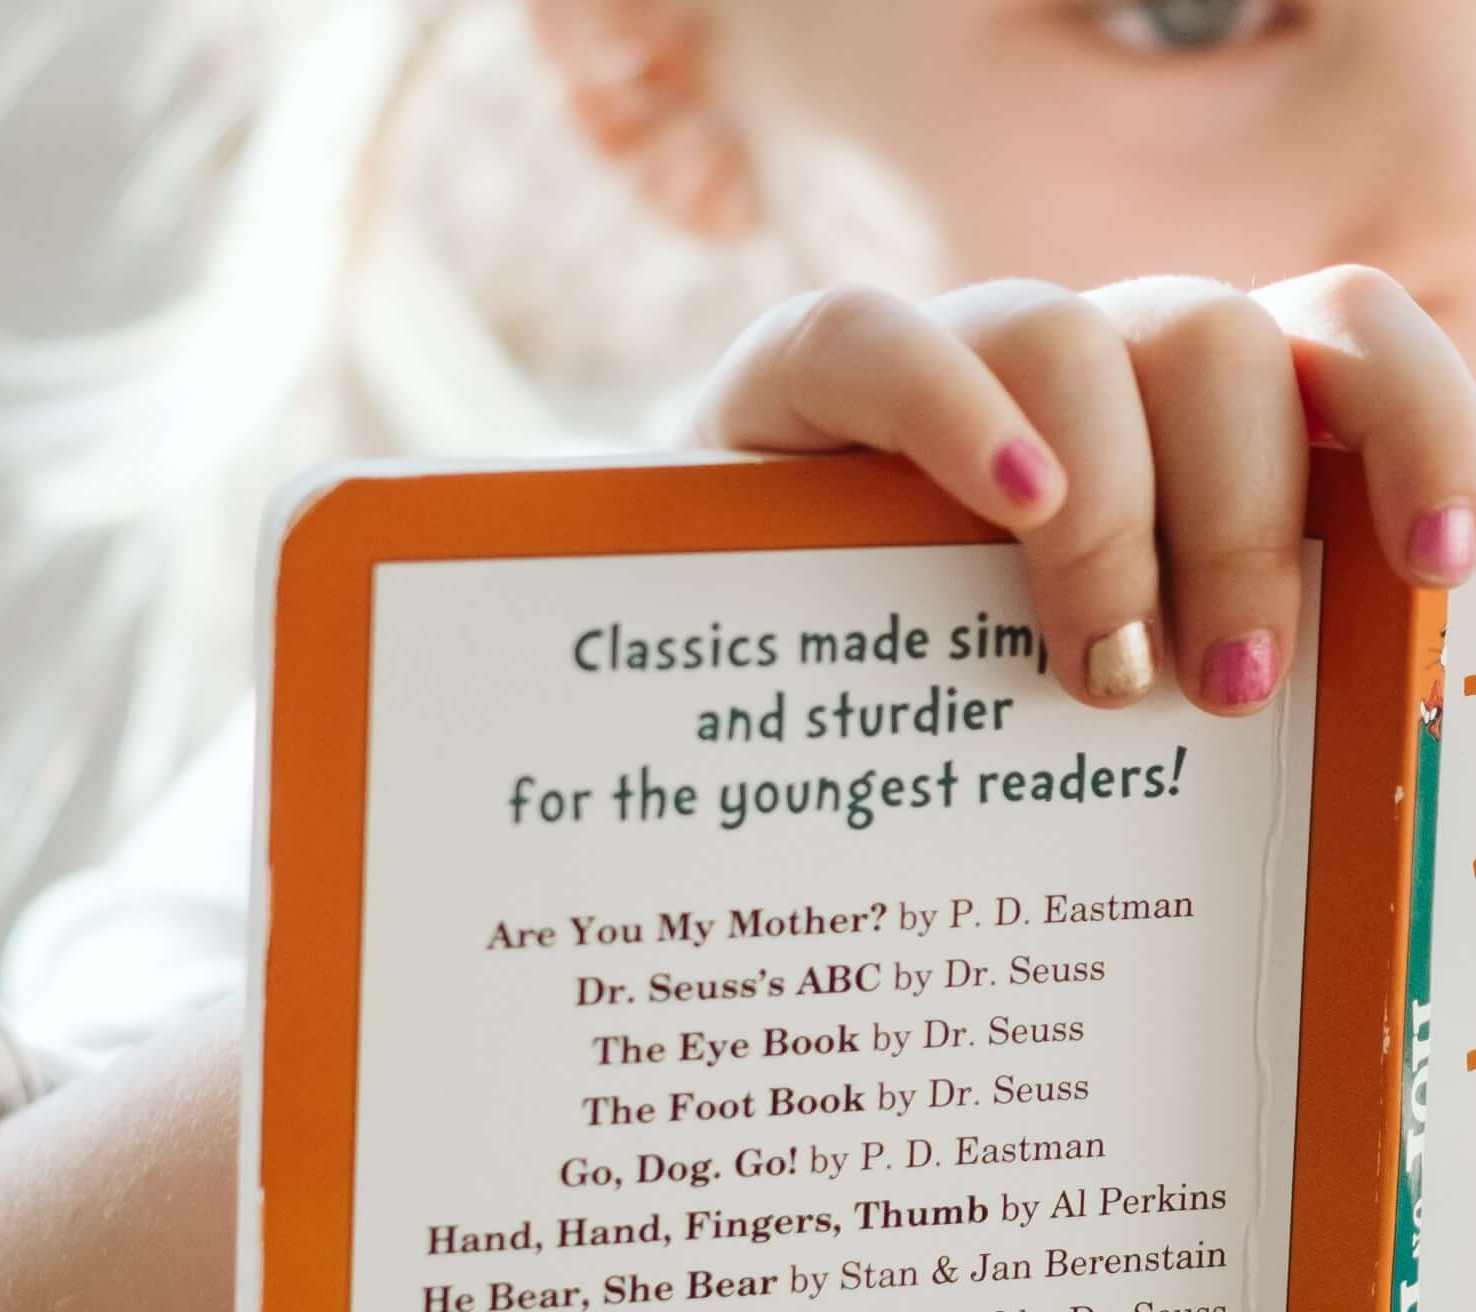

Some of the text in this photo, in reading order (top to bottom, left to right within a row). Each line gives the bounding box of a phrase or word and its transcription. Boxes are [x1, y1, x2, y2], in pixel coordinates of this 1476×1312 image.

[573, 622, 777, 672] Classics
[800, 612, 929, 664] made
[697, 685, 1013, 742] and sturdier
[509, 746, 1187, 830] for the youngest readers!
[487, 895, 1193, 949] Are You My Mother? by P. D. Eastman
[577, 956, 1104, 1006] Dr. Seuss's ABC by Dr. Seuss
[593, 1016, 1083, 1067] The Eye Book by Dr. Seuss
[583, 1075, 1088, 1126] The Foot Book by Dr. Seuss
[561, 1136, 1105, 1189] Go, Dog. Go! by P. D. Eastman
[428, 1184, 1226, 1255] Hand, Hand, Fingers, Thumb by Al Perkins
[488, 1283, 589, 1311] Bear,
[604, 1274, 673, 1304] She
[687, 1271, 778, 1299] Bear
[791, 1265, 828, 1299] by
[841, 1261, 917, 1289] Stan
[932, 1256, 958, 1285] &
[970, 1253, 1031, 1282] Jan
[1045, 1241, 1226, 1277] Berenstain
